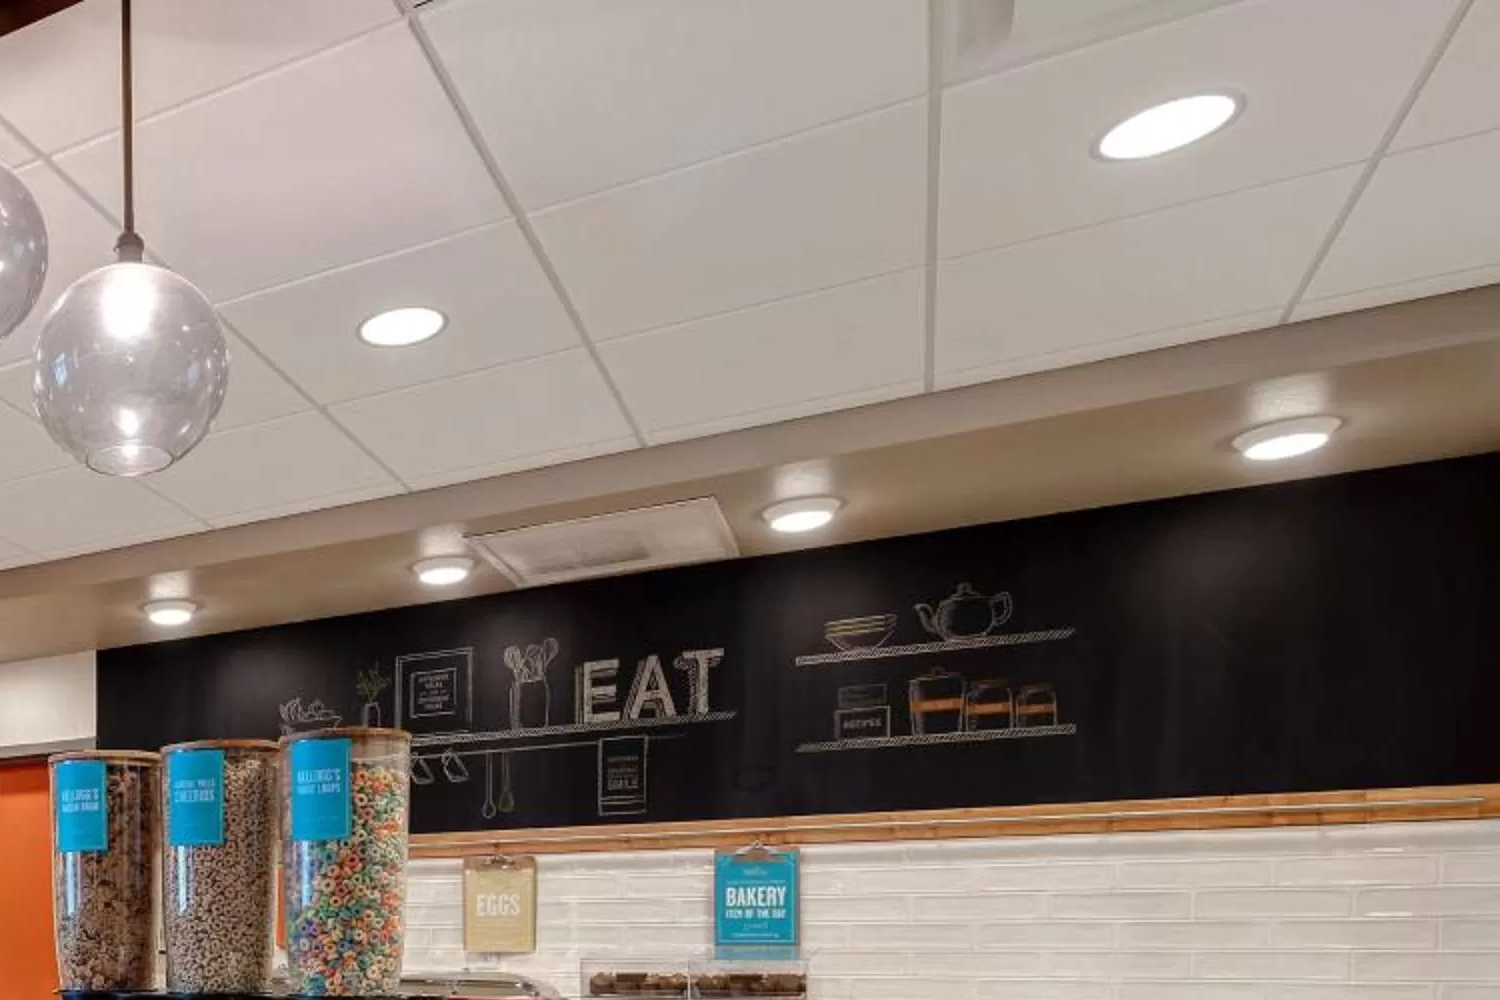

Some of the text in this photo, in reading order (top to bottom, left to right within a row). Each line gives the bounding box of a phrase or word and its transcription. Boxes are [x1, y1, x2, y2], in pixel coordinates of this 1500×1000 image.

[575, 648, 724, 724] EAT
[476, 893, 520, 917] EGGS
[726, 886, 787, 907] BAKERY
